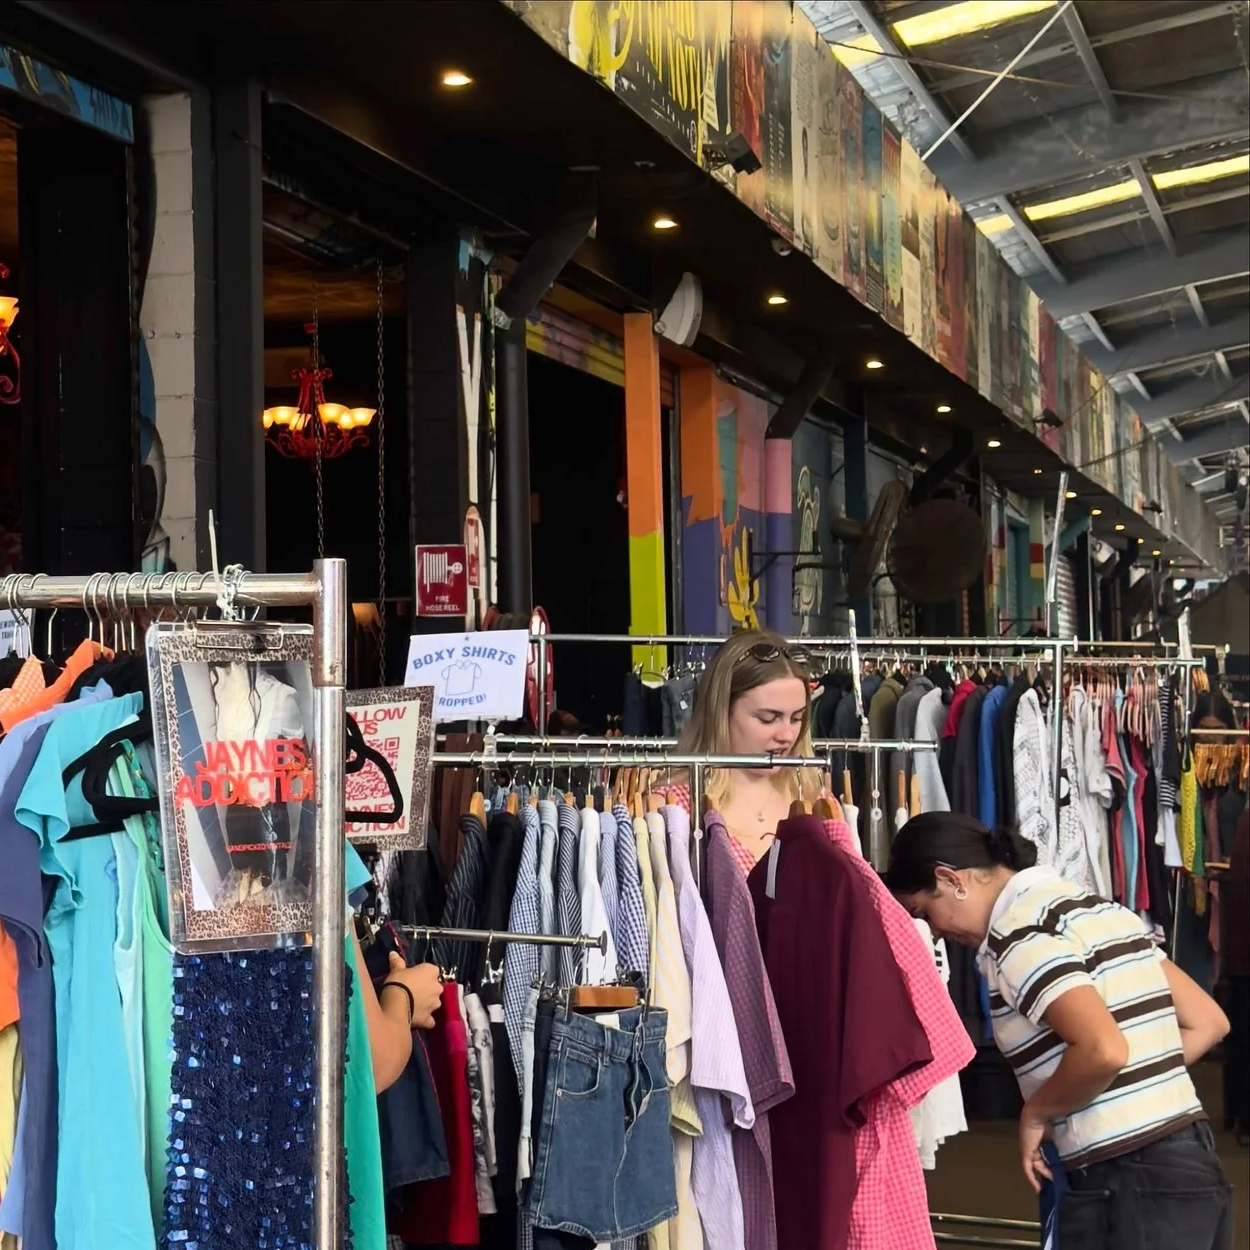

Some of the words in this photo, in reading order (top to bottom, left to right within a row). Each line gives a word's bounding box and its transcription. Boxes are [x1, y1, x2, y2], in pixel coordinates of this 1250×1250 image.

[443, 603, 460, 611] REEL
[413, 648, 455, 670] BOXY
[461, 646, 516, 666] SHIRTS
[438, 693, 487, 708] ROPPED!
[195, 739, 307, 773] JAYNES
